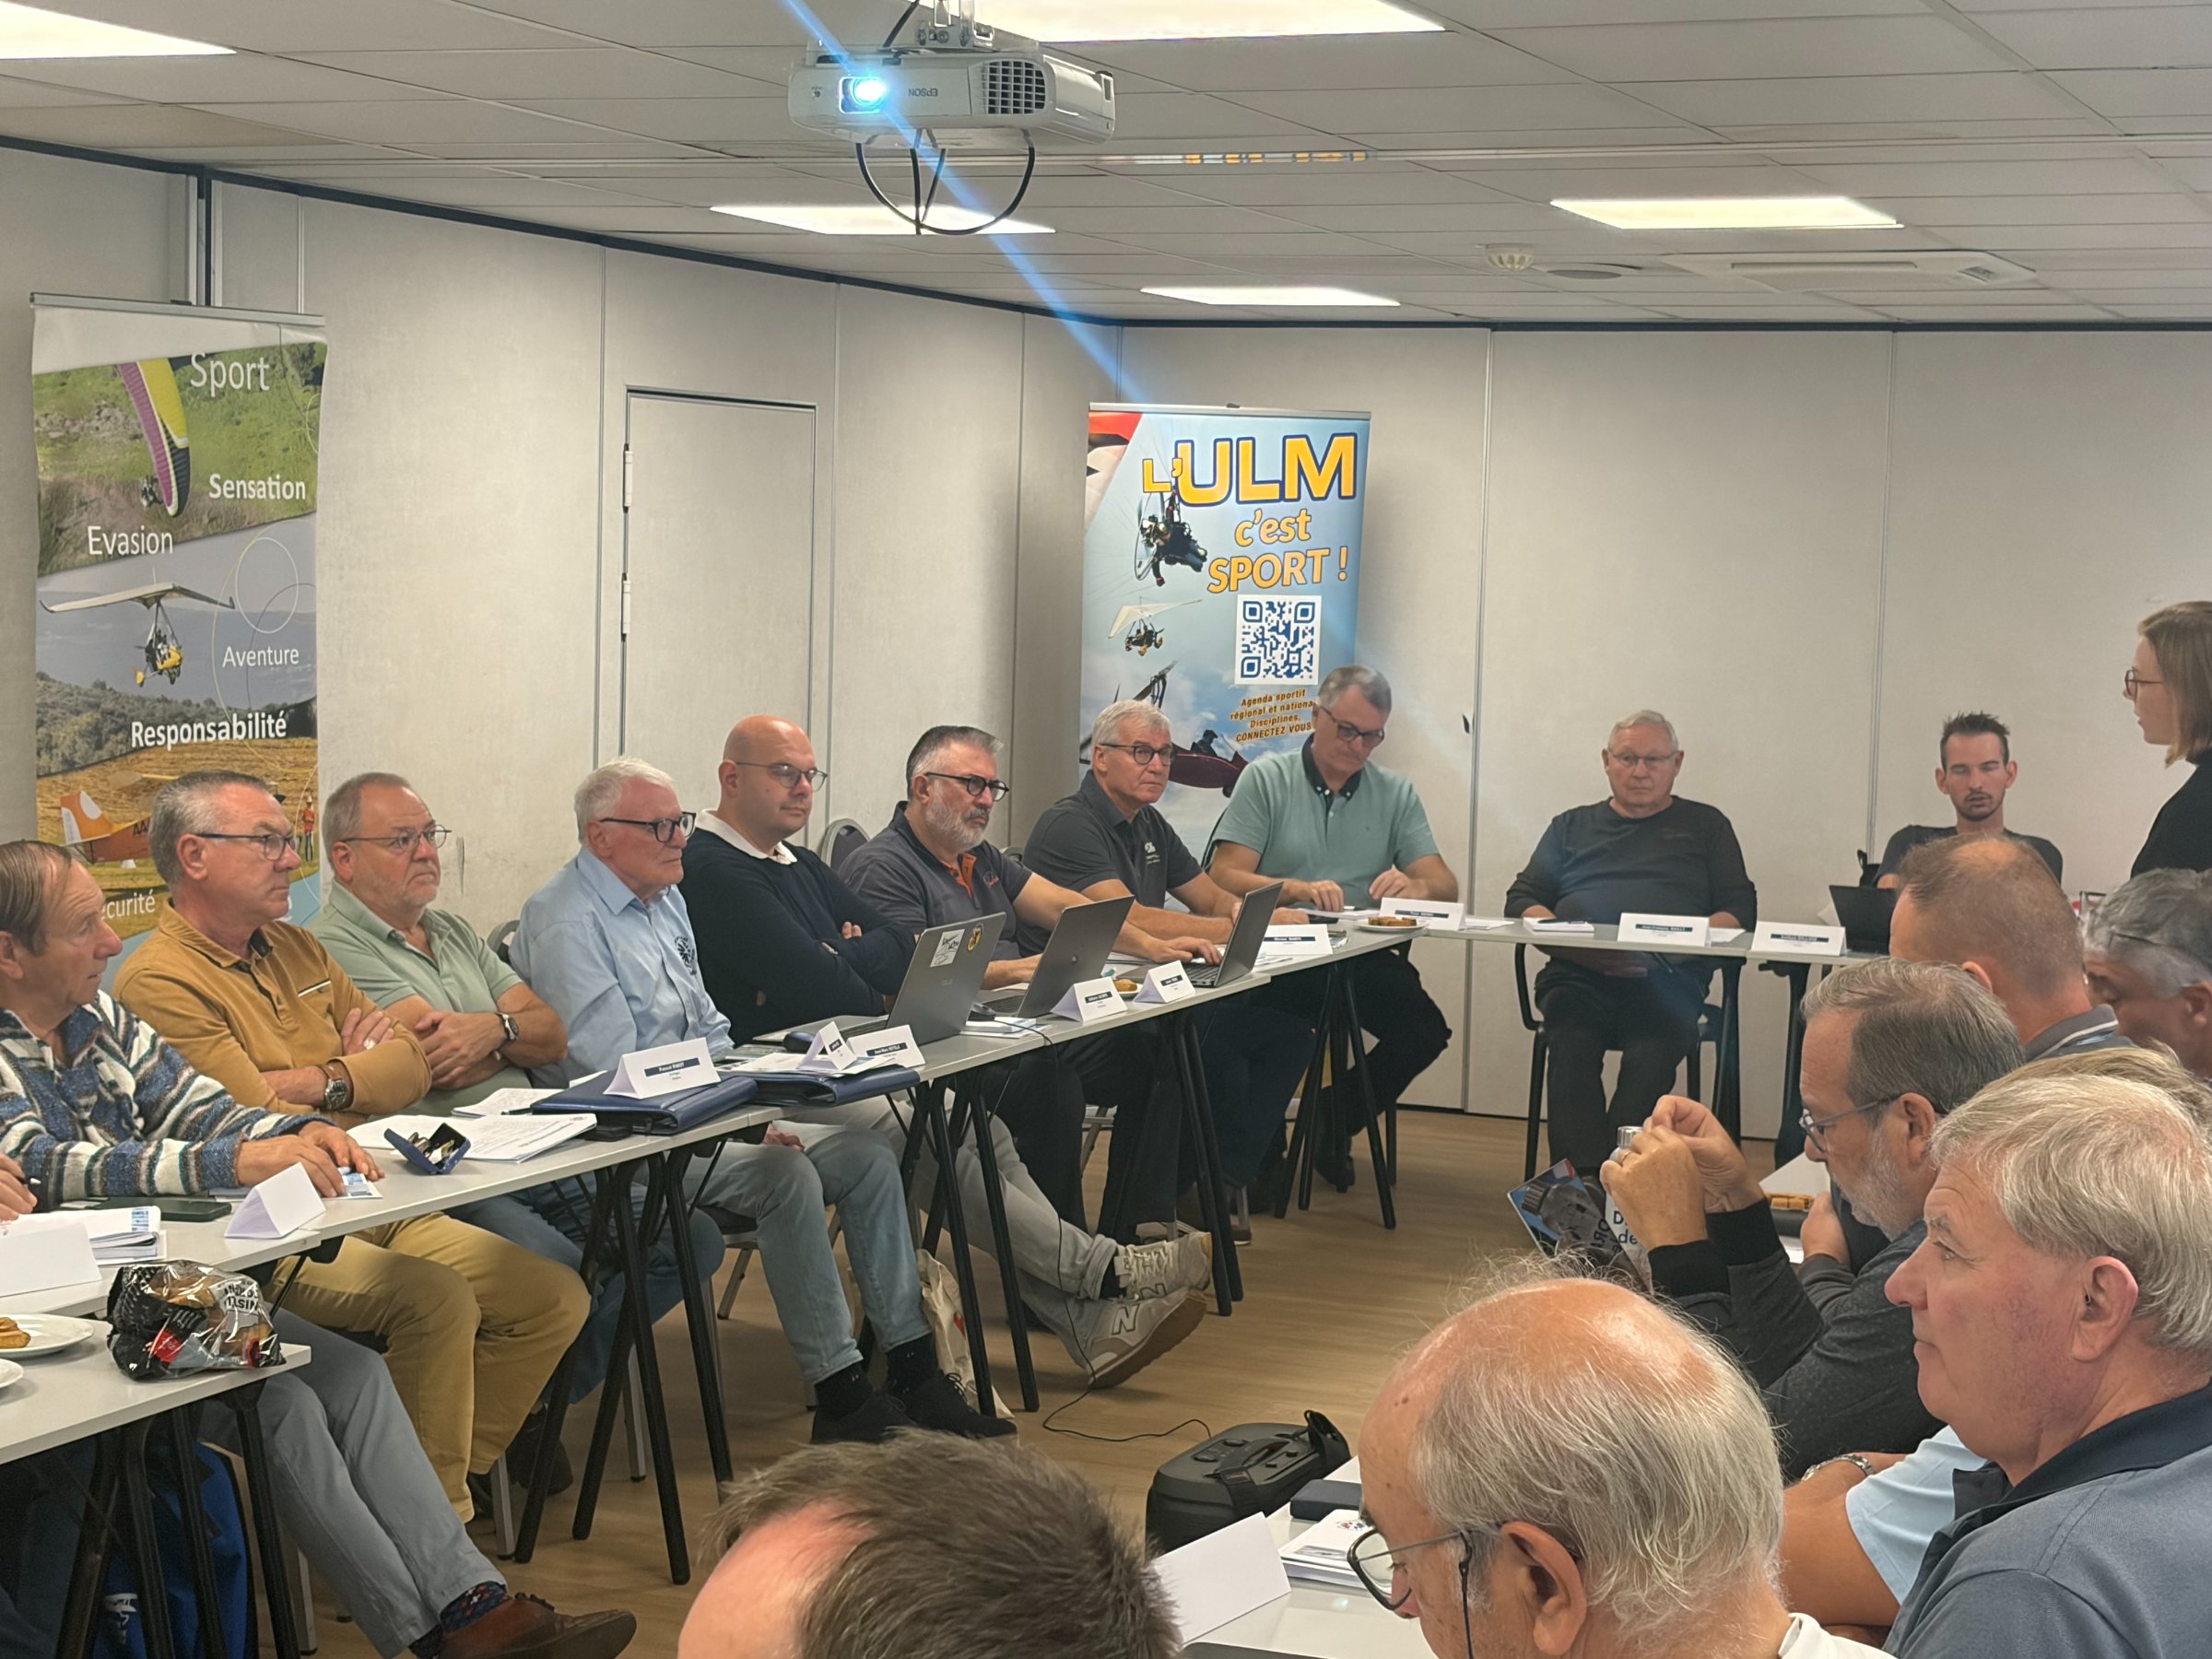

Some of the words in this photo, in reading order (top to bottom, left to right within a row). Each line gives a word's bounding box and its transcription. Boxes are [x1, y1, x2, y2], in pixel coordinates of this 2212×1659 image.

[908, 88, 938, 98] EPSON
[190, 352, 271, 397] Sport
[208, 474, 306, 500] Sensation
[87, 525, 173, 555] Evasion
[1234, 508, 1312, 547] c'est
[1206, 547, 1331, 594] SPORT
[222, 646, 300, 668] Aventure
[1241, 694, 1273, 708] Agenda
[1276, 688, 1306, 701] sportif
[1268, 705, 1277, 713] et
[1279, 700, 1313, 712] nationa
[132, 711, 288, 751] Responsabilité
[1236, 725, 1286, 743] CONNECTEZ
[1288, 722, 1312, 734] VOUS
